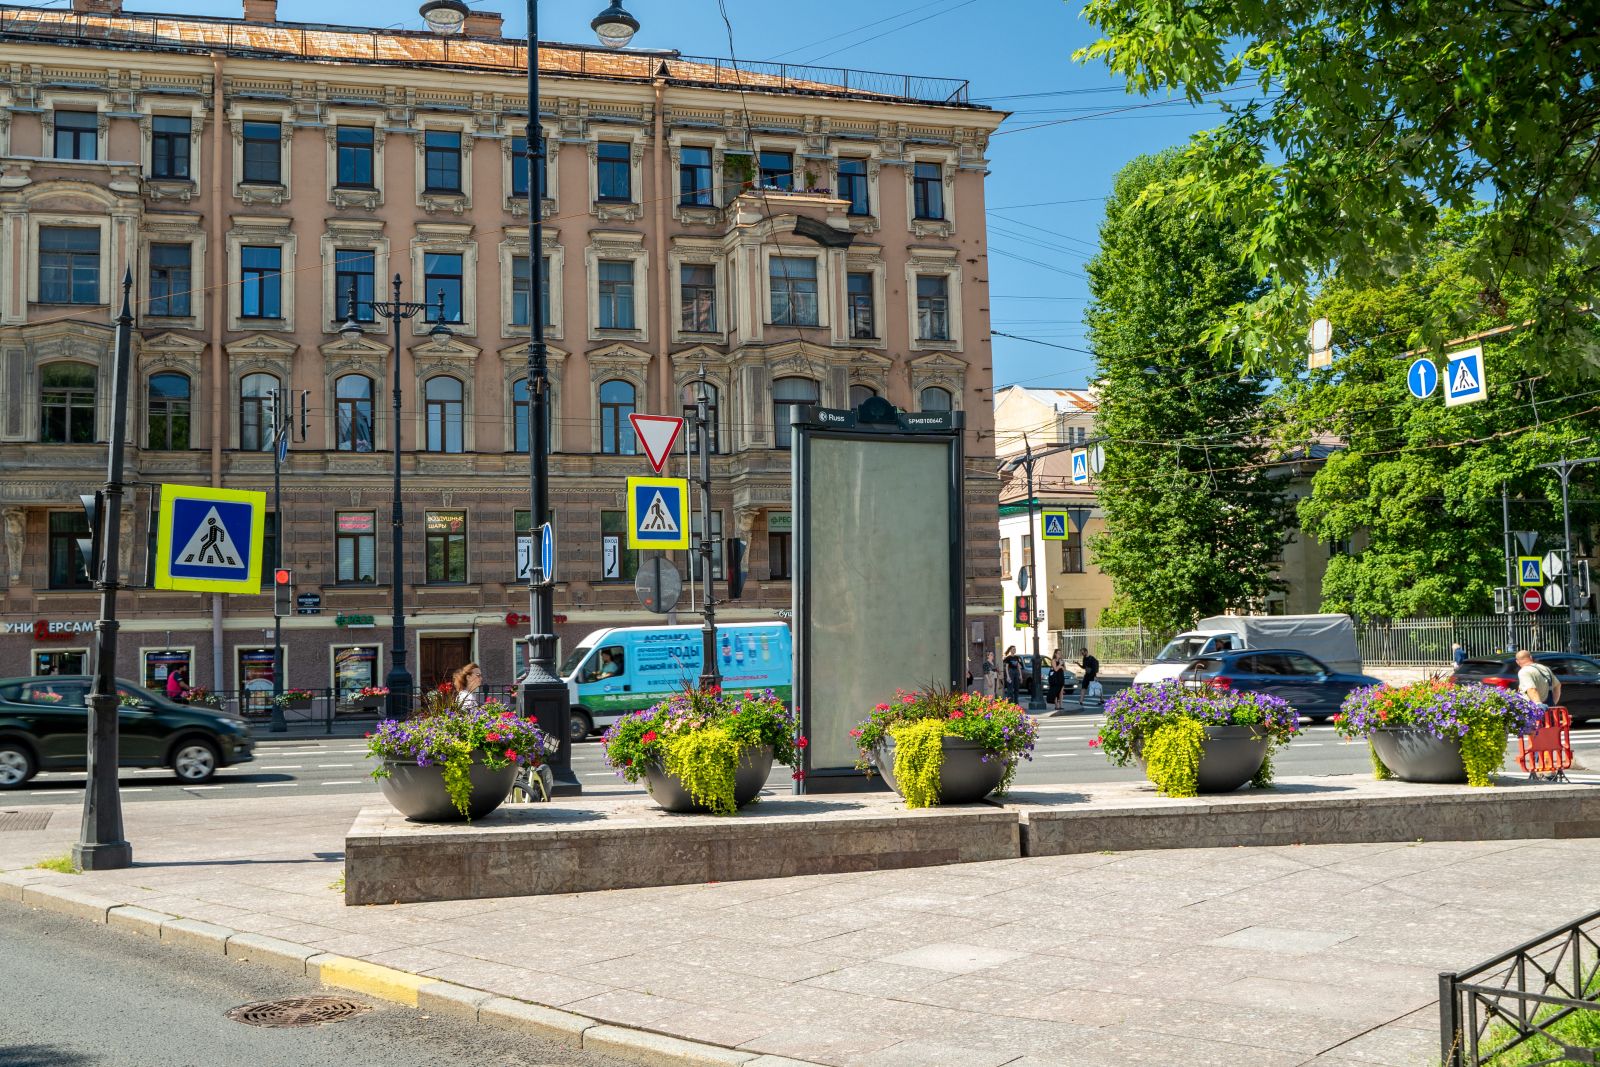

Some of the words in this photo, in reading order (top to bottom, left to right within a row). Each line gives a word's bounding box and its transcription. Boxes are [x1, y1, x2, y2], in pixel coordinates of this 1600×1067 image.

[828, 413, 845, 422] Russ
[5, 618, 95, 641] УНИВЕРСАМ
[643, 633, 691, 643] ДОСТАВКА
[667, 645, 700, 659] ВОДЫ
[638, 662, 667, 672] ДОМОЙ
